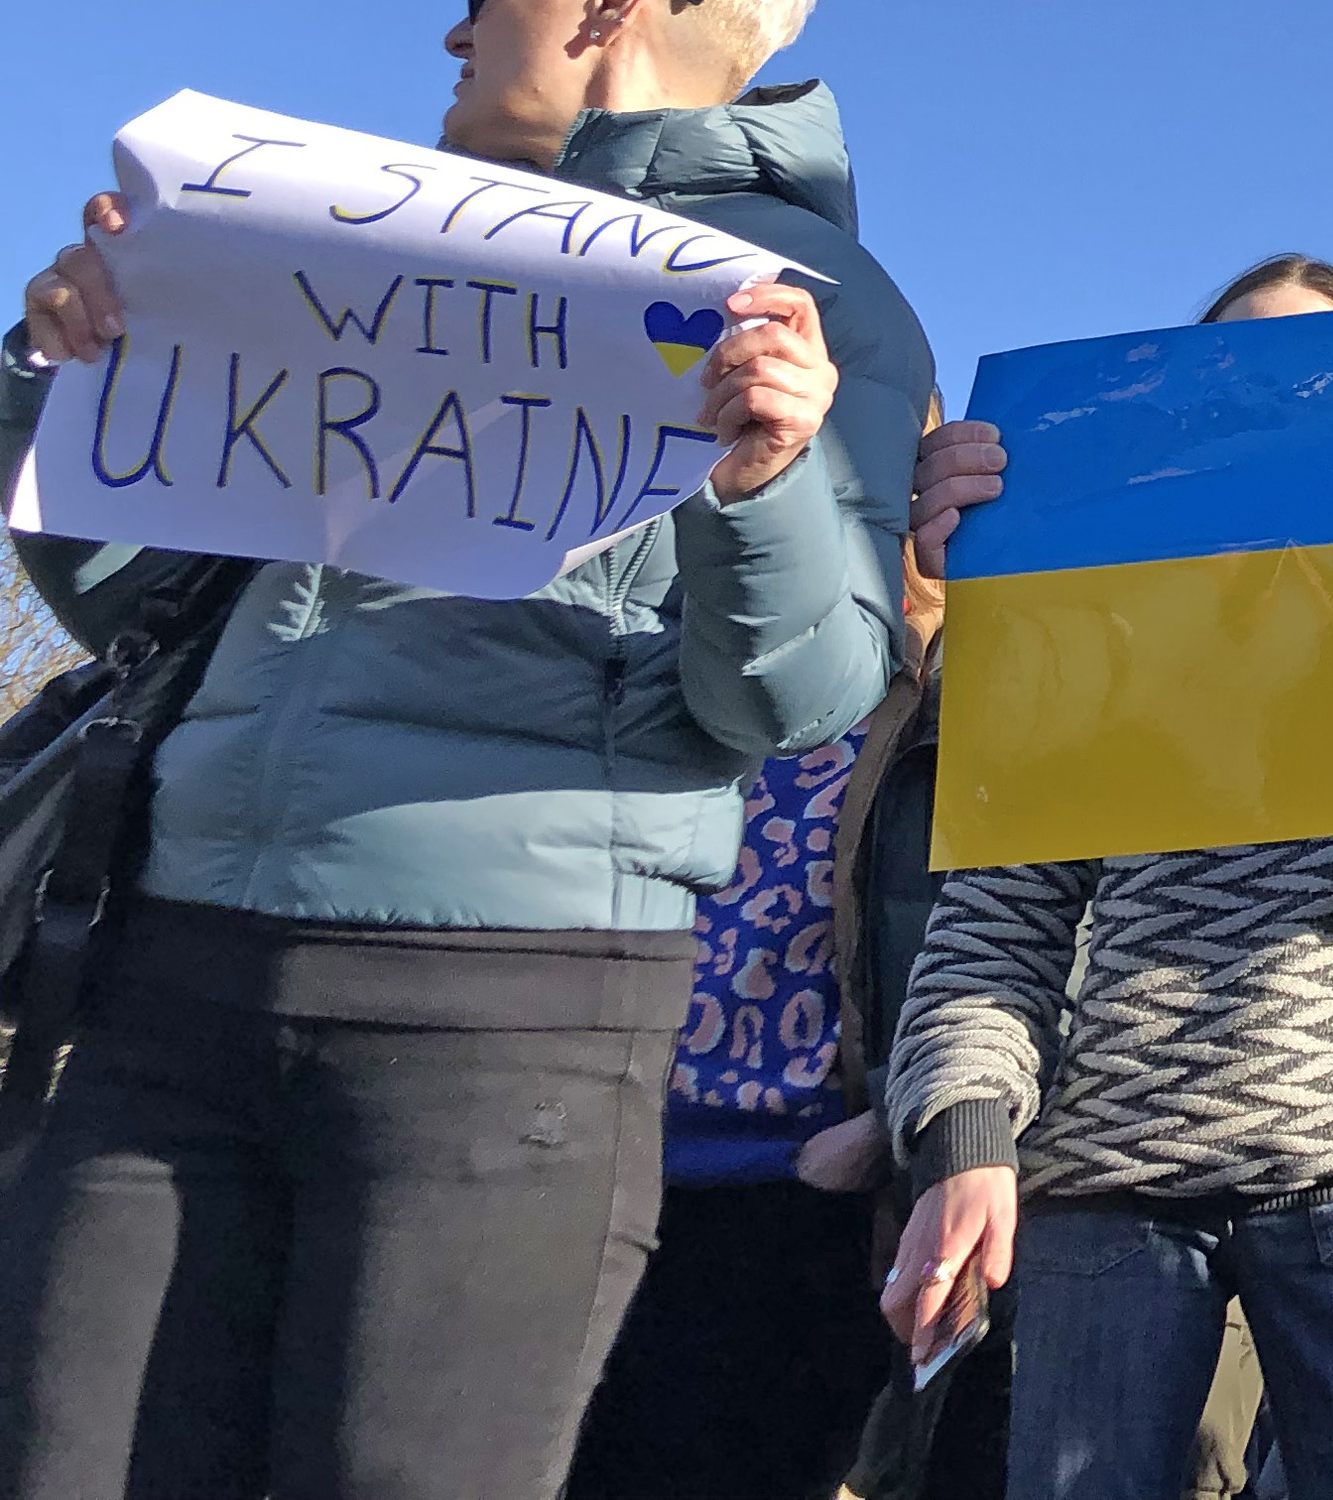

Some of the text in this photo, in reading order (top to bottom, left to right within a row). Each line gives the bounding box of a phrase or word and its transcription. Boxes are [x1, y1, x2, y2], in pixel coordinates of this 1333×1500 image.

[181, 133, 306, 198] I
[294, 269, 568, 370] WITH
[91, 335, 719, 543] UKRAINE
